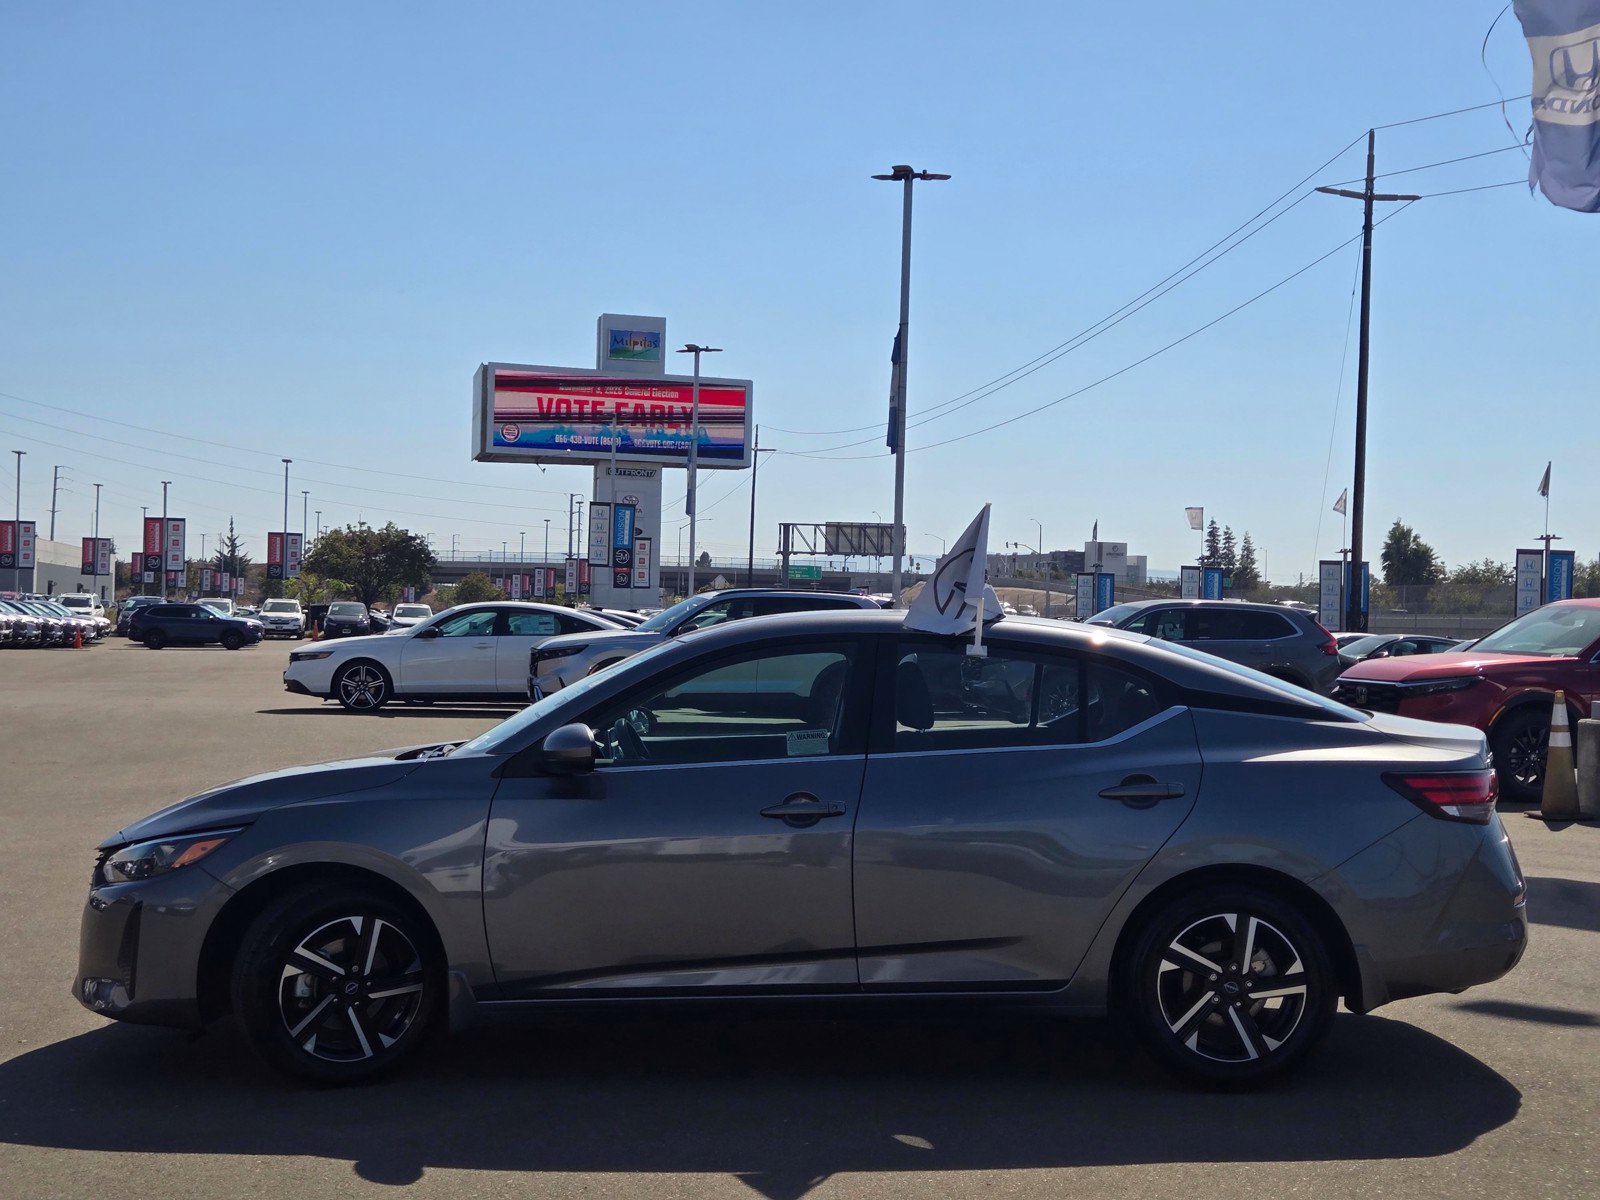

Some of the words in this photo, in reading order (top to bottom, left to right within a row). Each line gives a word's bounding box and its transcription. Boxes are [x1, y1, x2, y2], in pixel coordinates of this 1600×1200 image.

[612, 333, 658, 352] Milpitas
[537, 397, 606, 424] VOTE
[615, 402, 694, 429] EARLY
